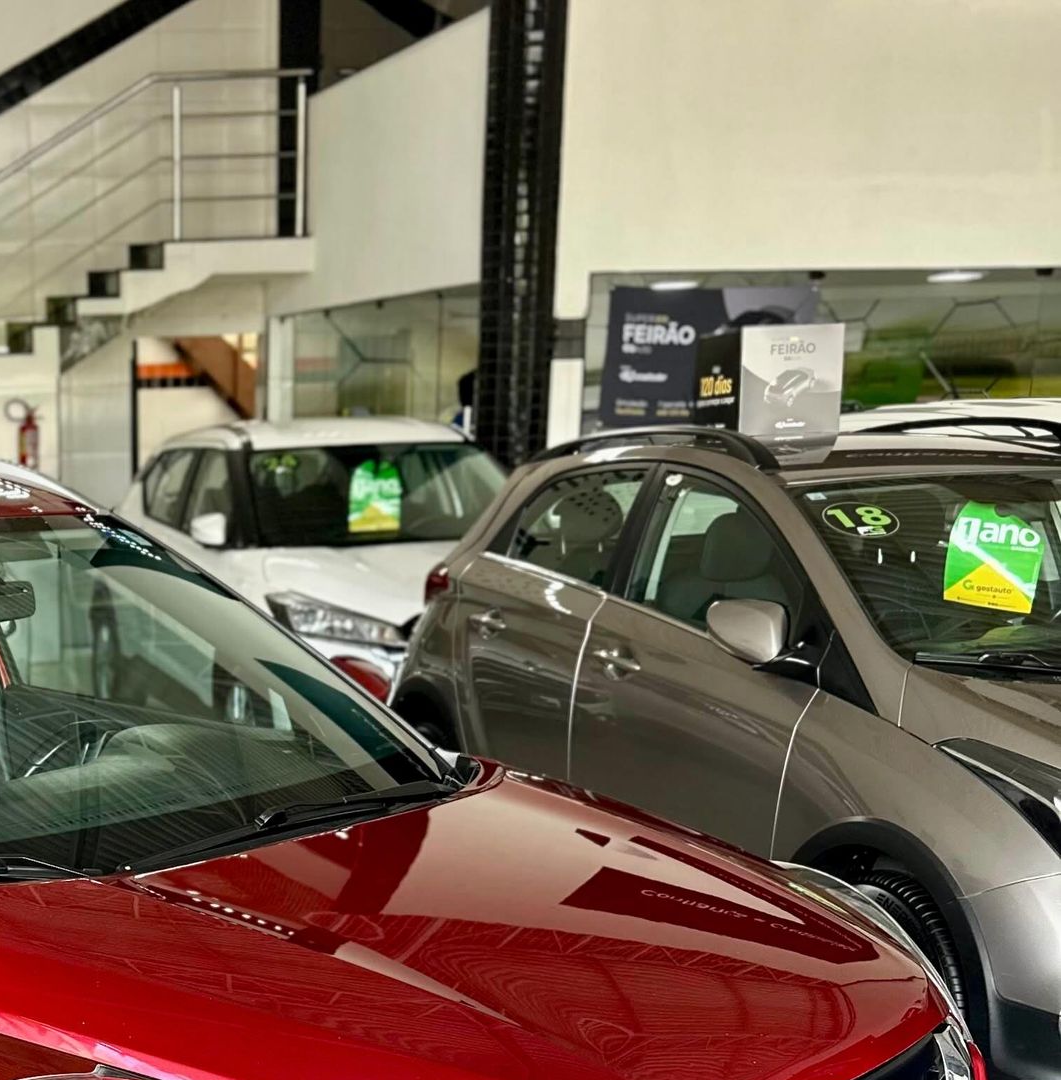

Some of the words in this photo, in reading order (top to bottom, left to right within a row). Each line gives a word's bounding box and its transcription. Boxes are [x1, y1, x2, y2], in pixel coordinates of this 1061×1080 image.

[622, 321, 696, 346] FEIRÃO
[770, 340, 816, 355] FEIRÃO
[826, 506, 891, 528] 18
